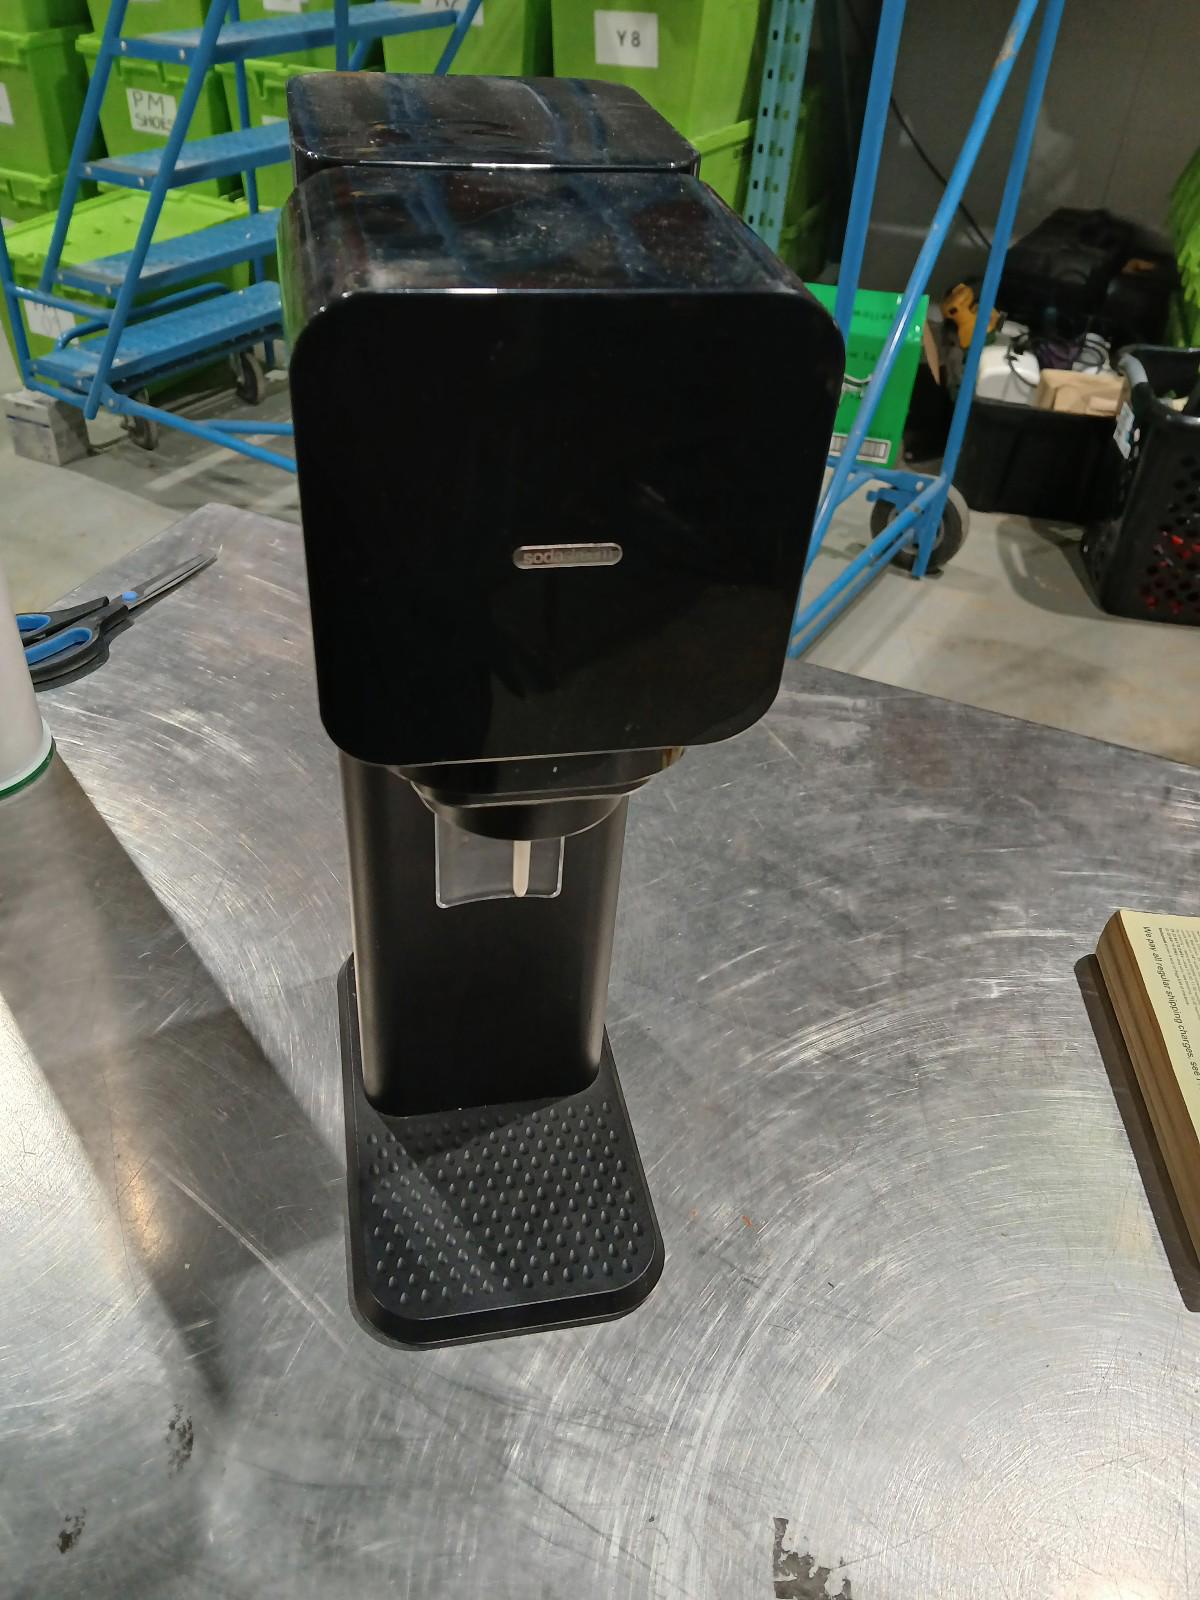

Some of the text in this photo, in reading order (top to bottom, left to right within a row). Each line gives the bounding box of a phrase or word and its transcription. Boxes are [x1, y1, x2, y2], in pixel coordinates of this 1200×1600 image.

[1143, 926, 1153, 938] We
[1146, 939, 1157, 951] pay
[1152, 953, 1163, 962] all
[1156, 963, 1171, 990] regular
[1166, 991, 1183, 1023] shipping
